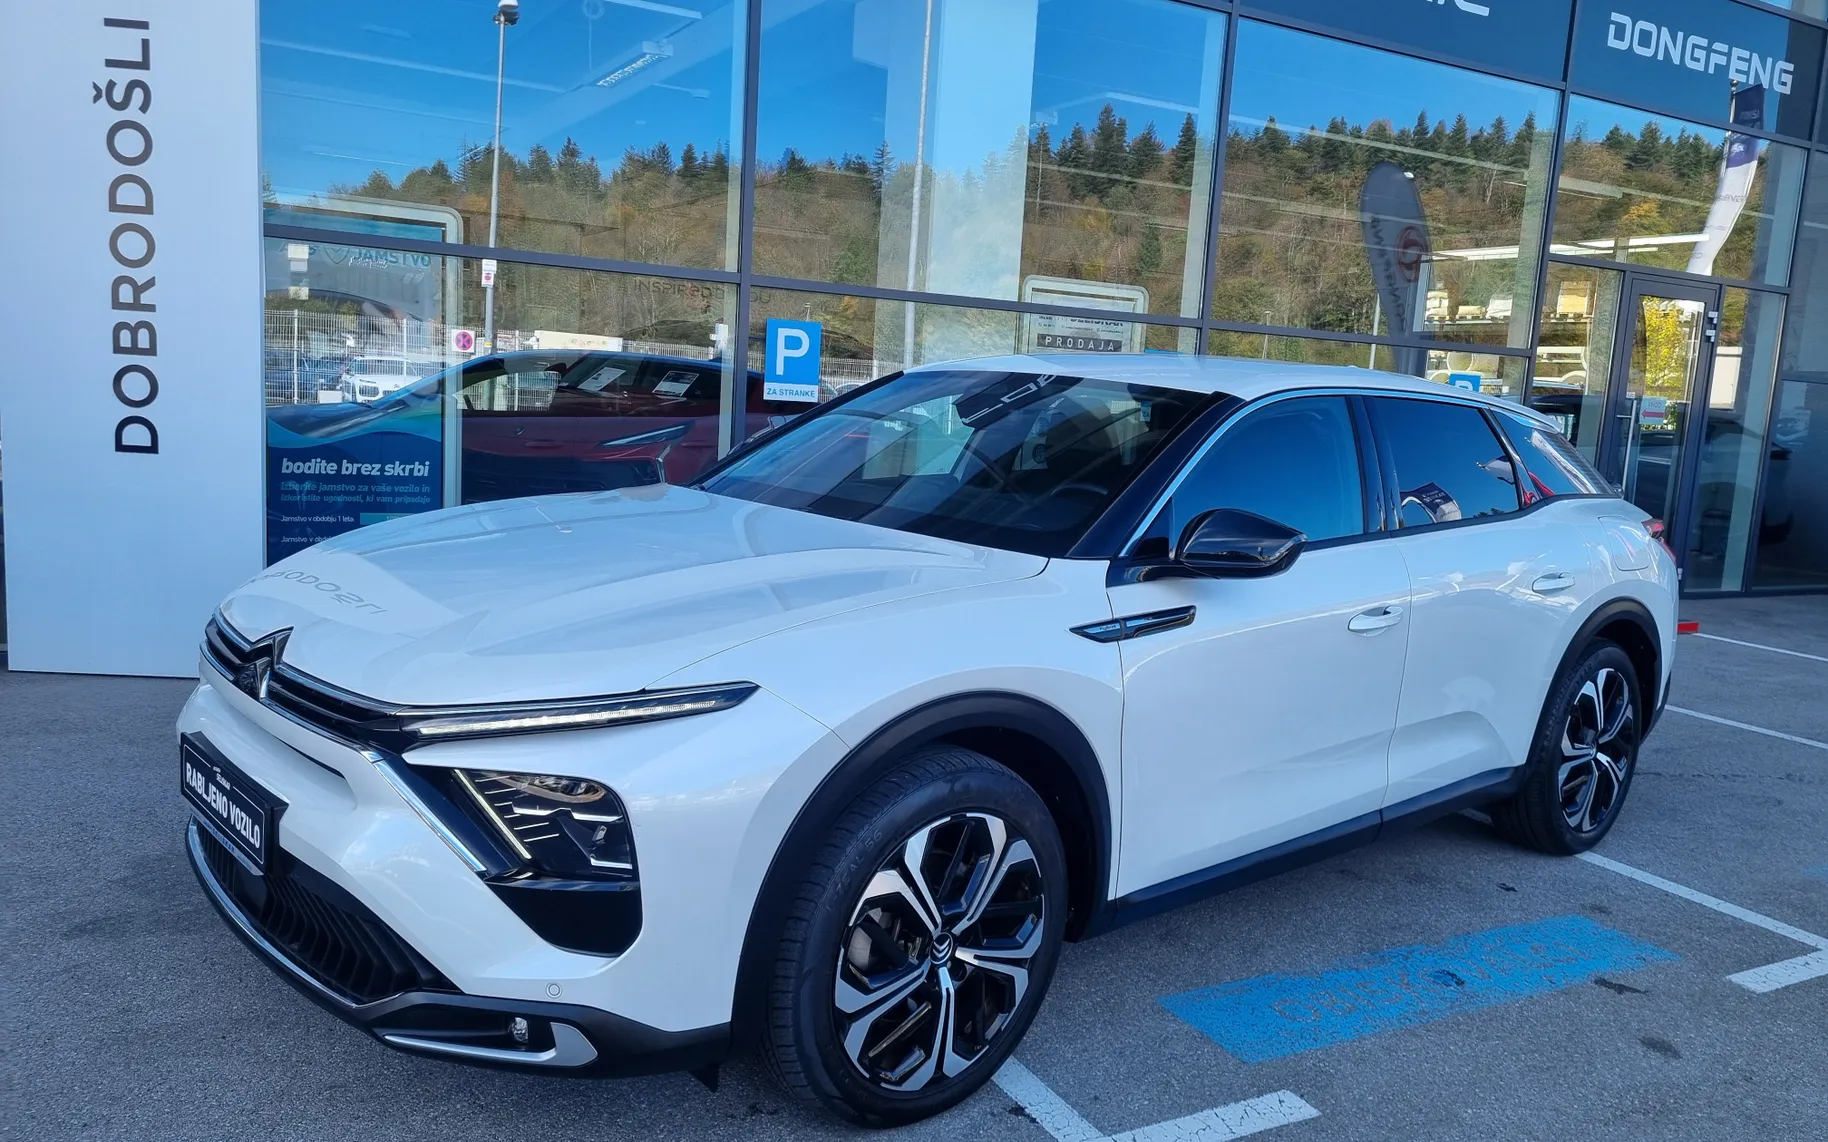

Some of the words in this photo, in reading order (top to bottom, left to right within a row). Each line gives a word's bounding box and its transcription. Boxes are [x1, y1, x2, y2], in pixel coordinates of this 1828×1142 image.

[1607, 12, 1794, 95] DONGFENG
[93, 17, 159, 454] DOBRODOŠLI
[776, 328, 809, 375] P
[1045, 336, 1115, 351] PRODAJA
[780, 389, 815, 397] STRANKE
[282, 458, 337, 474] bodite
[341, 460, 381, 475] brez
[384, 461, 430, 476] skrbi
[318, 482, 355, 492] jamstvo
[371, 483, 392, 492] vaše
[394, 484, 420, 492] vozilo
[421, 484, 430, 492] in
[186, 762, 228, 818] RABLJENO
[229, 801, 260, 849] VOZILO
